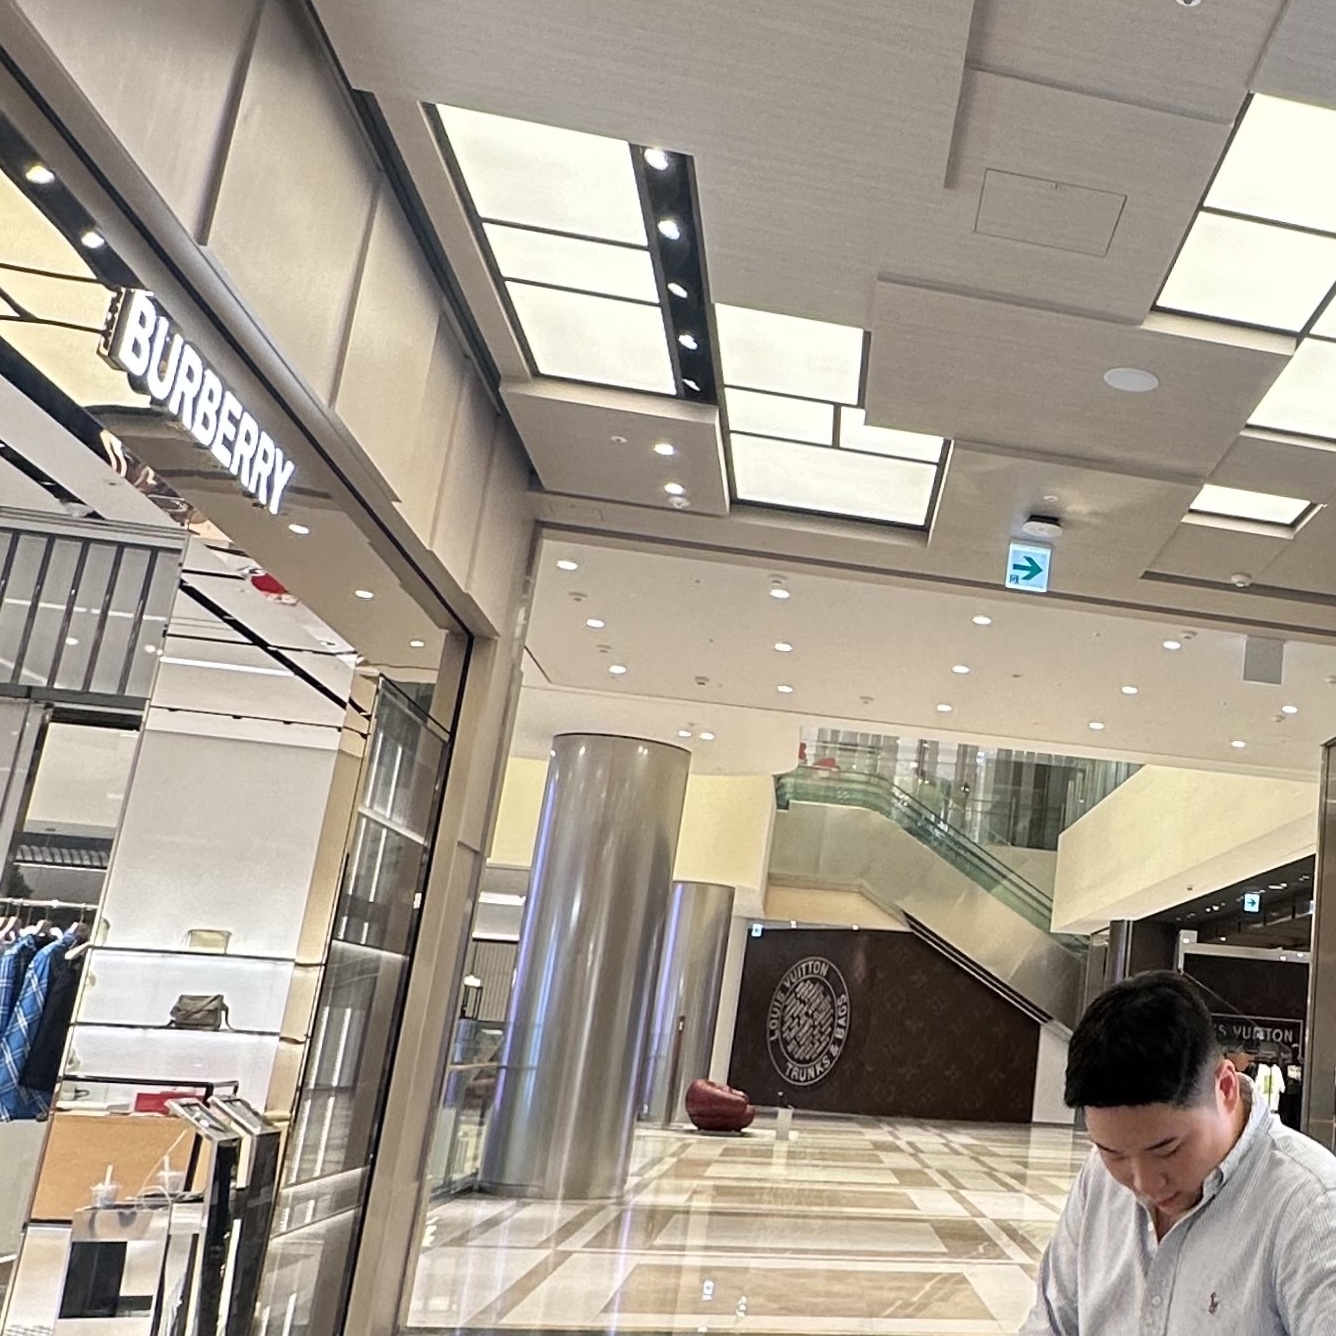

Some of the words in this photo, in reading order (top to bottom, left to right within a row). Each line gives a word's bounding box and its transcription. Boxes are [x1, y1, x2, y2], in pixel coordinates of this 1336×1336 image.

[118, 289, 295, 515] BURBERRY
[769, 990, 785, 1041] LOUIS
[783, 961, 829, 988] VUITTON
[785, 1055, 831, 1081] TRUNKS
[834, 993, 847, 1040] BAGS
